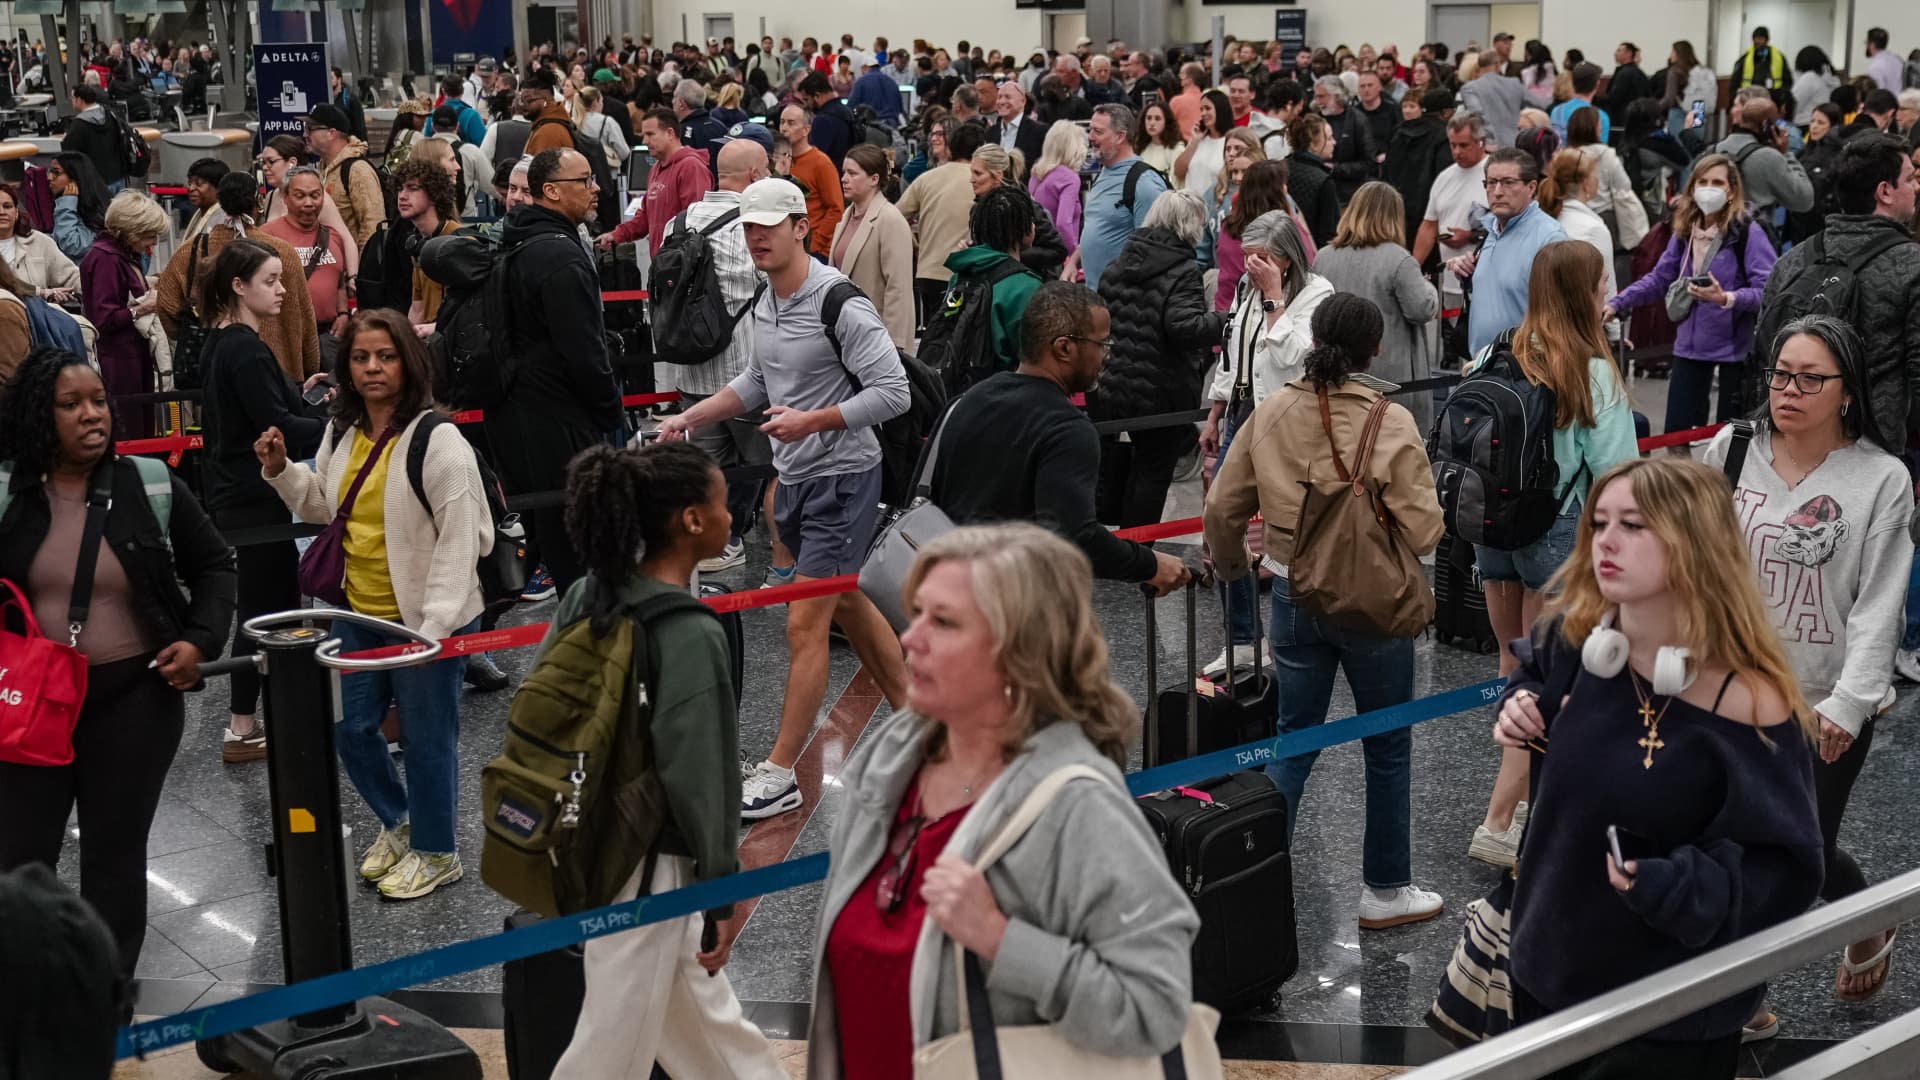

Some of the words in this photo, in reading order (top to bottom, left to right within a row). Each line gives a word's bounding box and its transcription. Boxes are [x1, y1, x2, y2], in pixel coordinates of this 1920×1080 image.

[272, 52, 309, 62] DELTA
[264, 121, 281, 131] APP
[283, 121, 301, 131] BAG
[190, 437, 204, 448] AT
[0, 688, 23, 706] AG
[1480, 687, 1497, 701] TSA
[1235, 750, 1255, 765] TSA
[1254, 747, 1271, 761] Pre
[579, 915, 607, 935] TSA
[607, 911, 632, 928] Pre
[162, 1023, 192, 1042] Pre
